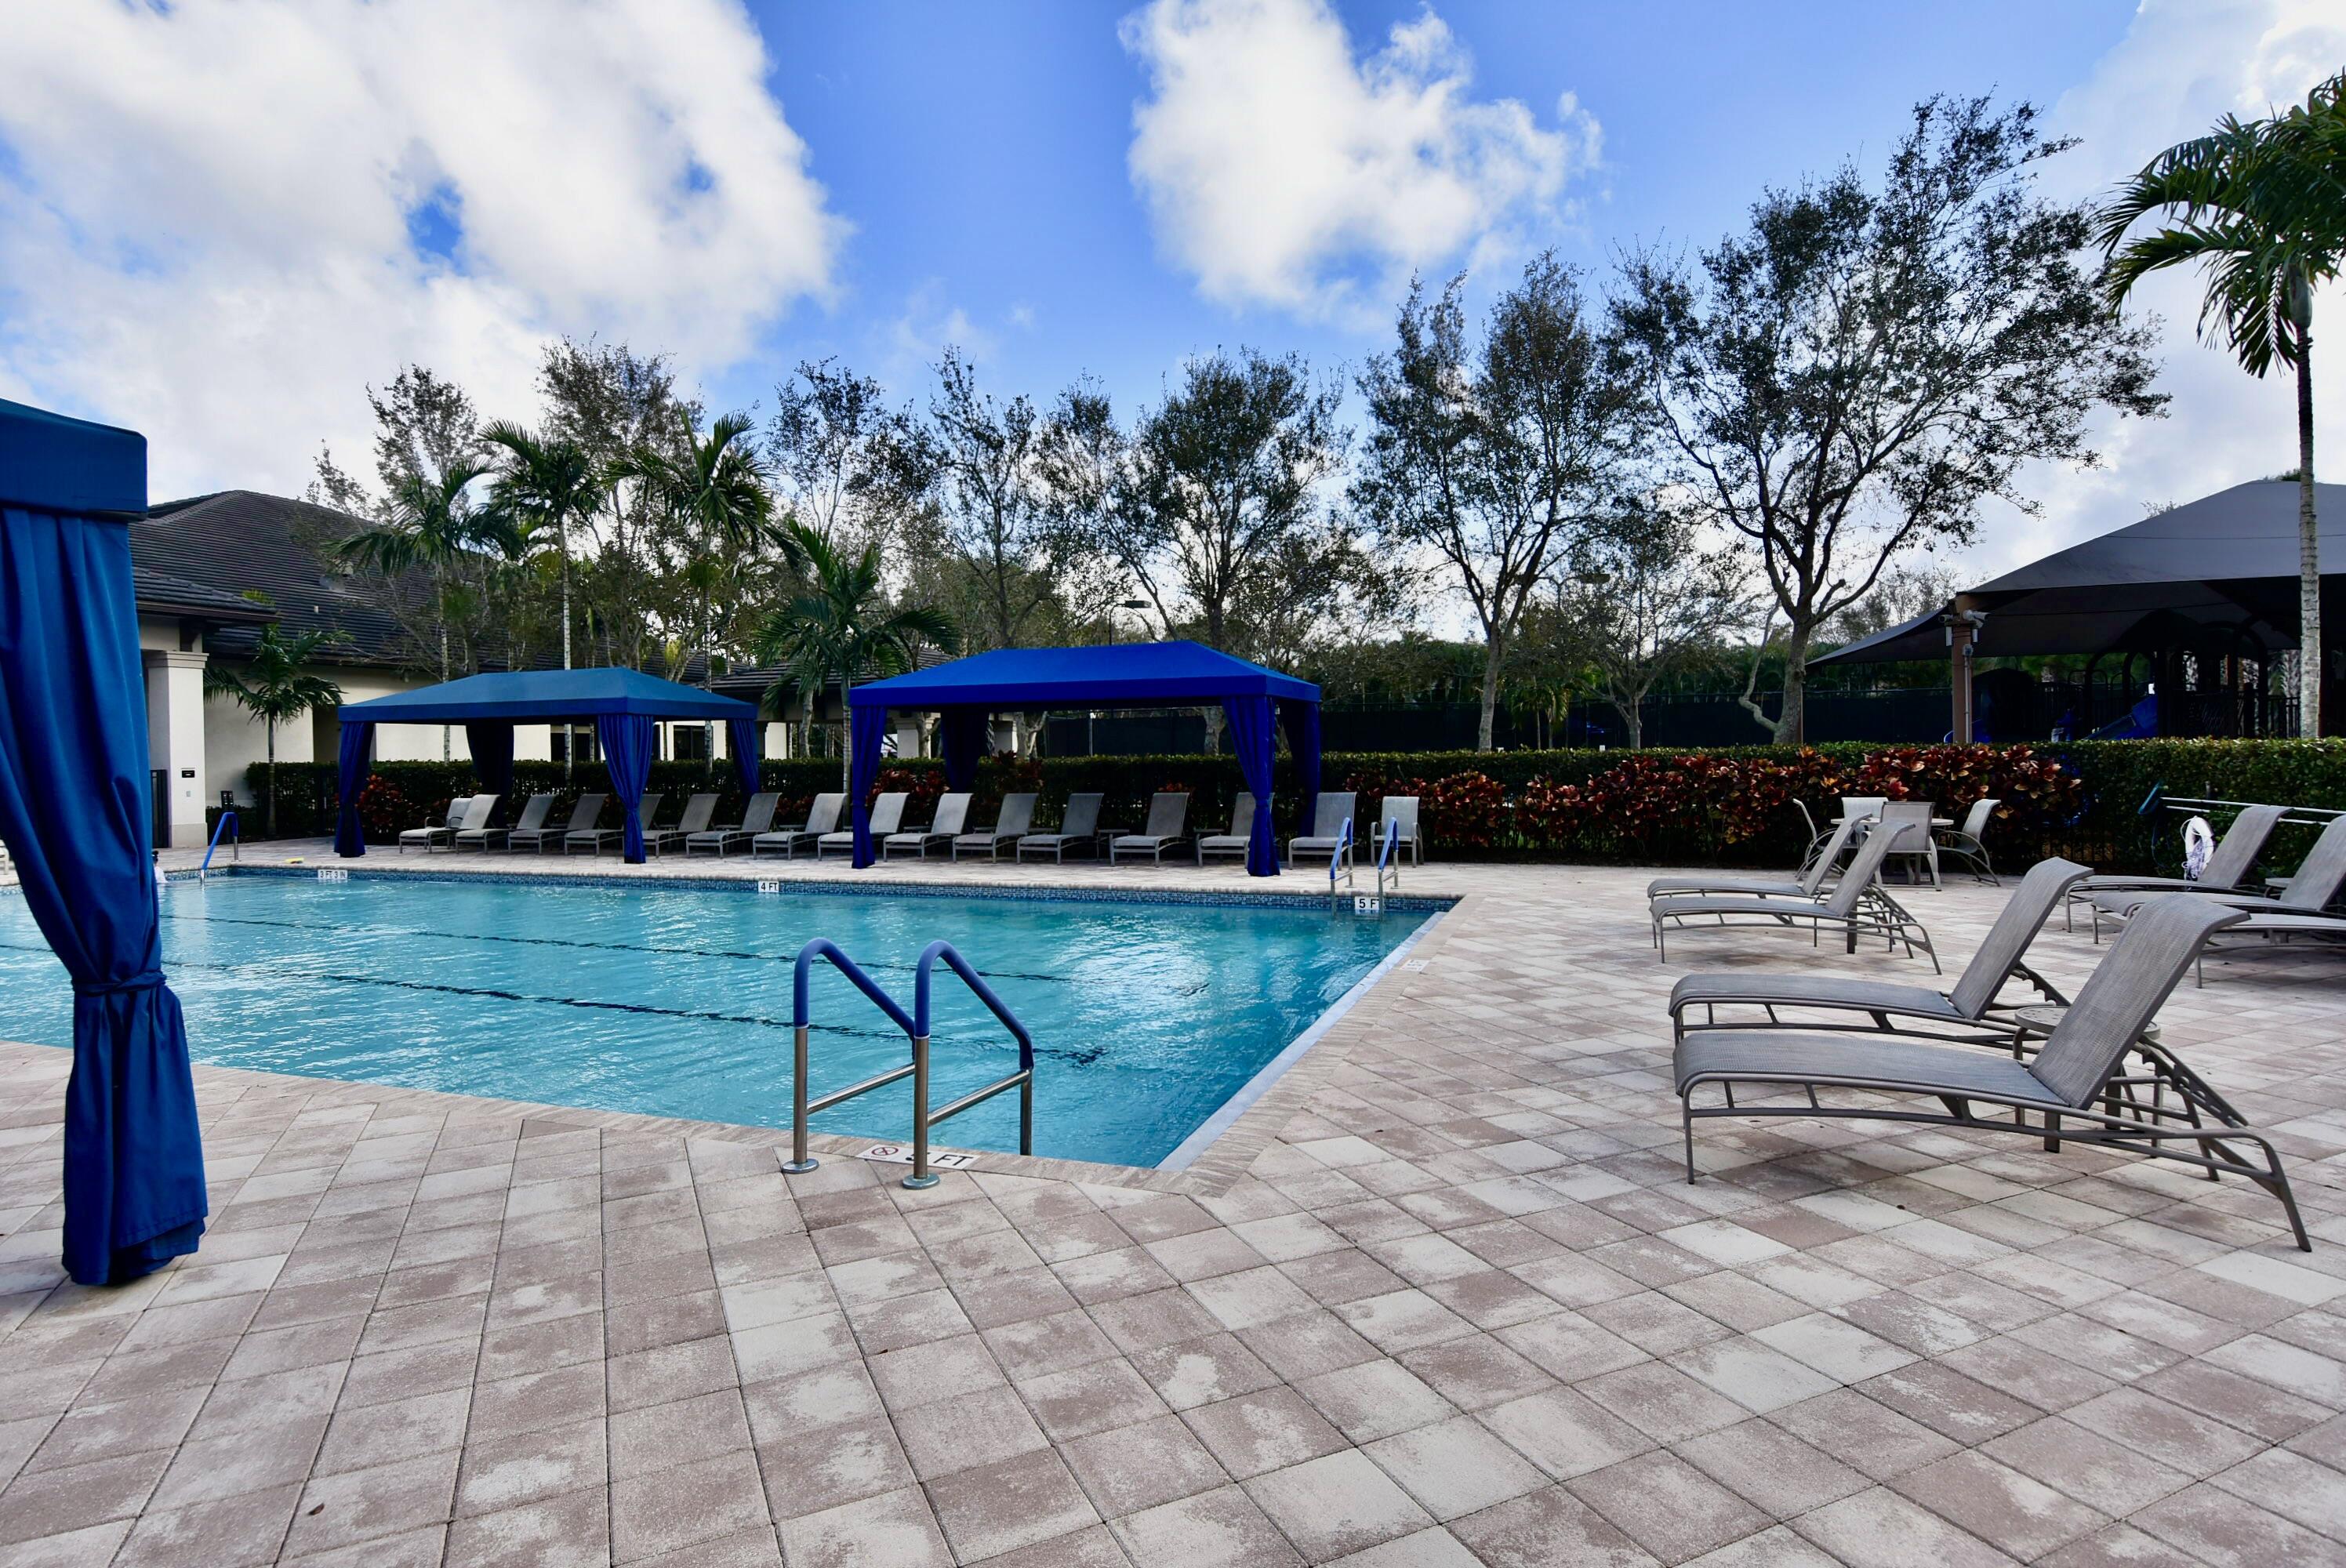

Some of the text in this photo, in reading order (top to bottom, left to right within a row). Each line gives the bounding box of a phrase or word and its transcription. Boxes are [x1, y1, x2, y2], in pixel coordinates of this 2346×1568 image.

[761, 882, 766, 891] 4
[1359, 898, 1379, 909] 5 F
[933, 1154, 974, 1166] FT
